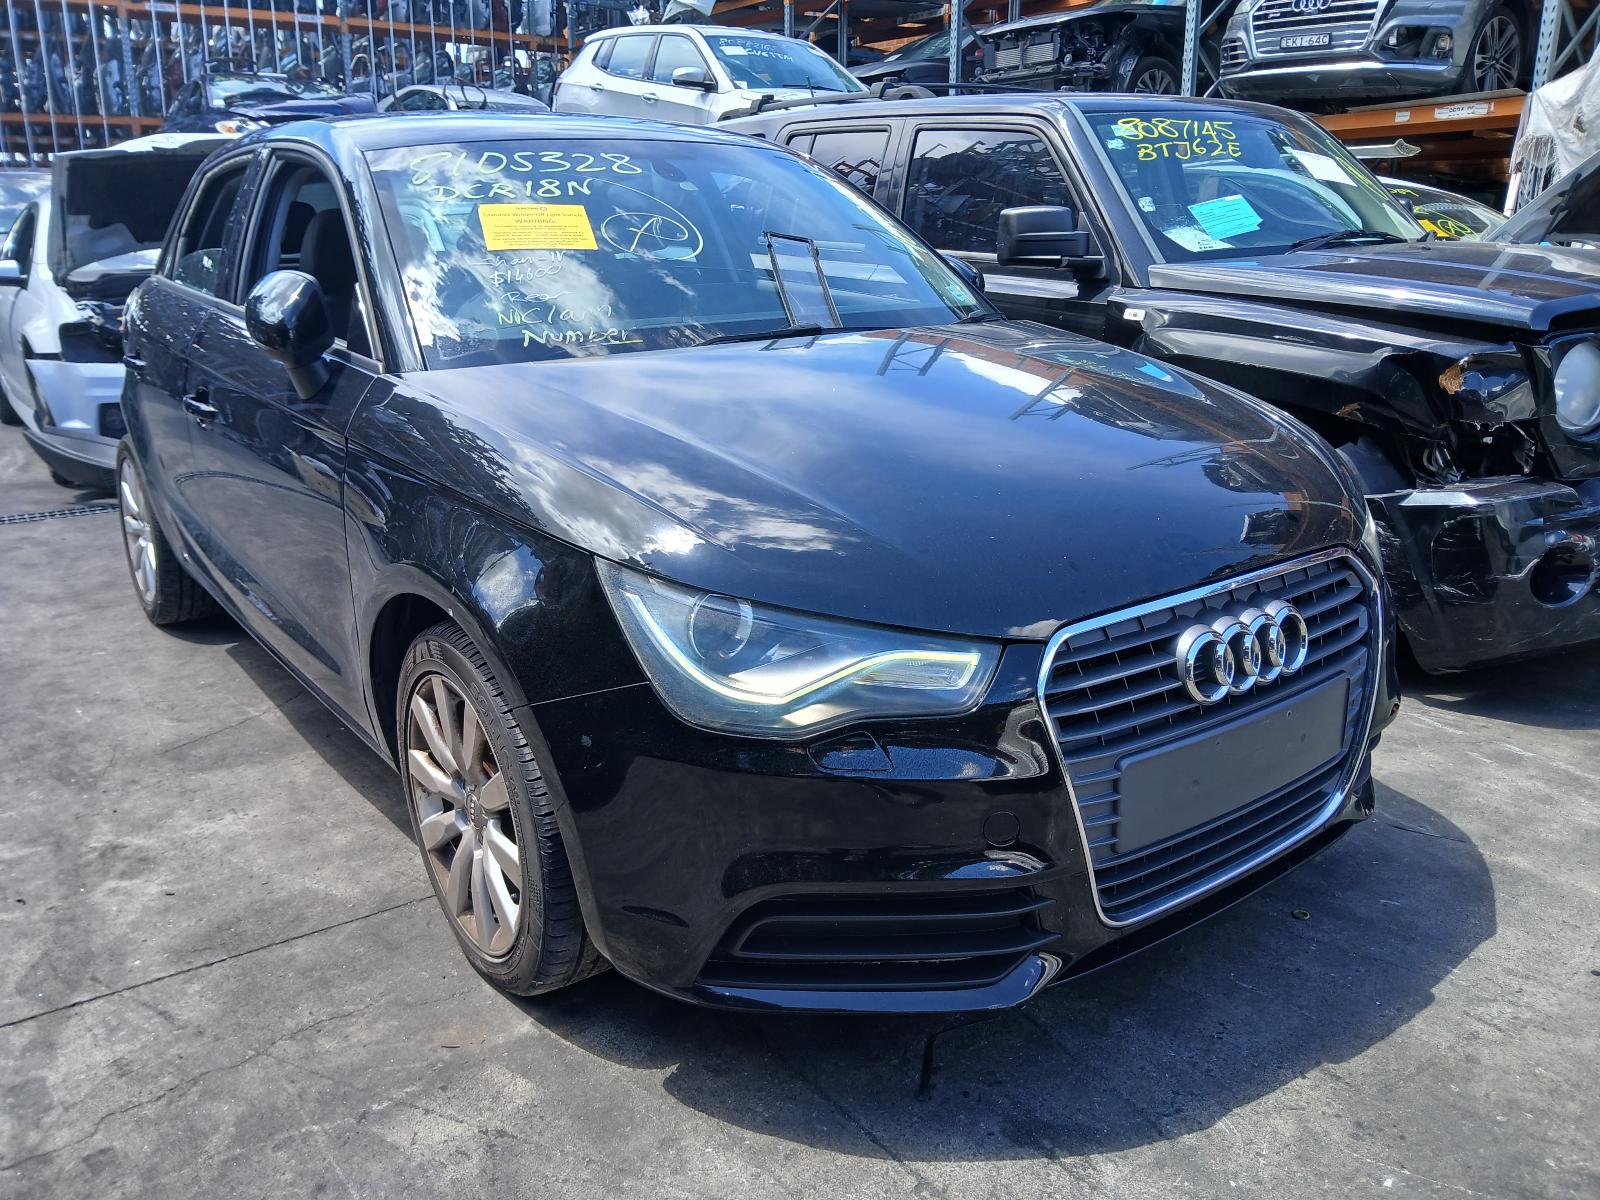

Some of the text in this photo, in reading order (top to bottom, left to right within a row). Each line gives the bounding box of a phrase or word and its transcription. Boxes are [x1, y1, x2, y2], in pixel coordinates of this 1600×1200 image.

[1118, 118, 1236, 142] 8087145
[1137, 138, 1241, 161] BTJ62E
[410, 151, 642, 185] 8105328
[428, 177, 594, 201] DCR18N
